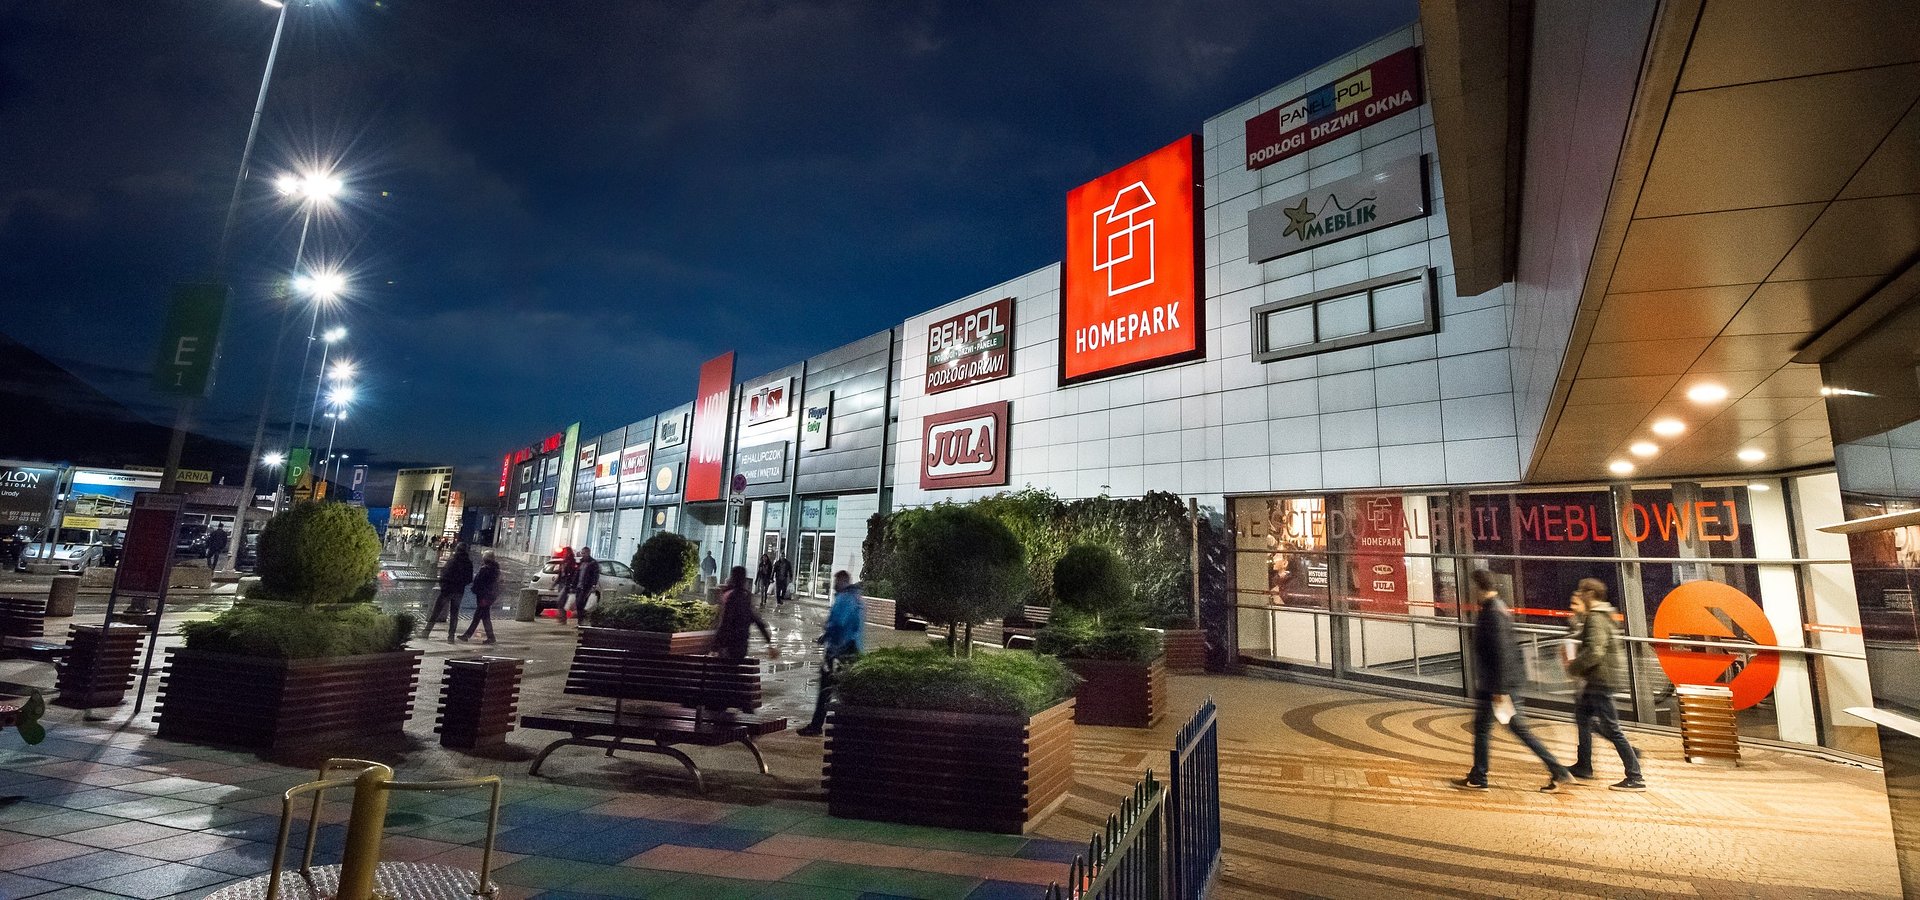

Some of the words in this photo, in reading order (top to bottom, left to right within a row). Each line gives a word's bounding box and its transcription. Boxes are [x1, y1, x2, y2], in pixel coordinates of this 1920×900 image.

[1280, 80, 1371, 127] PANEL-POL
[1249, 133, 1305, 166] PODŁOGI
[1310, 110, 1359, 141] DRZWI
[1364, 89, 1413, 118] OKNA
[1305, 204, 1377, 241] MEBLIK
[1075, 301, 1180, 354] HOMEPARK
[174, 336, 198, 365] E
[927, 363, 969, 388] PODŁOGI
[928, 424, 994, 467] JULA
[292, 466, 302, 477] D
[1512, 500, 1739, 542] MEBLOWEJ
[1361, 537, 1402, 547] HOMEPARK
[1373, 581, 1394, 591] JULA
